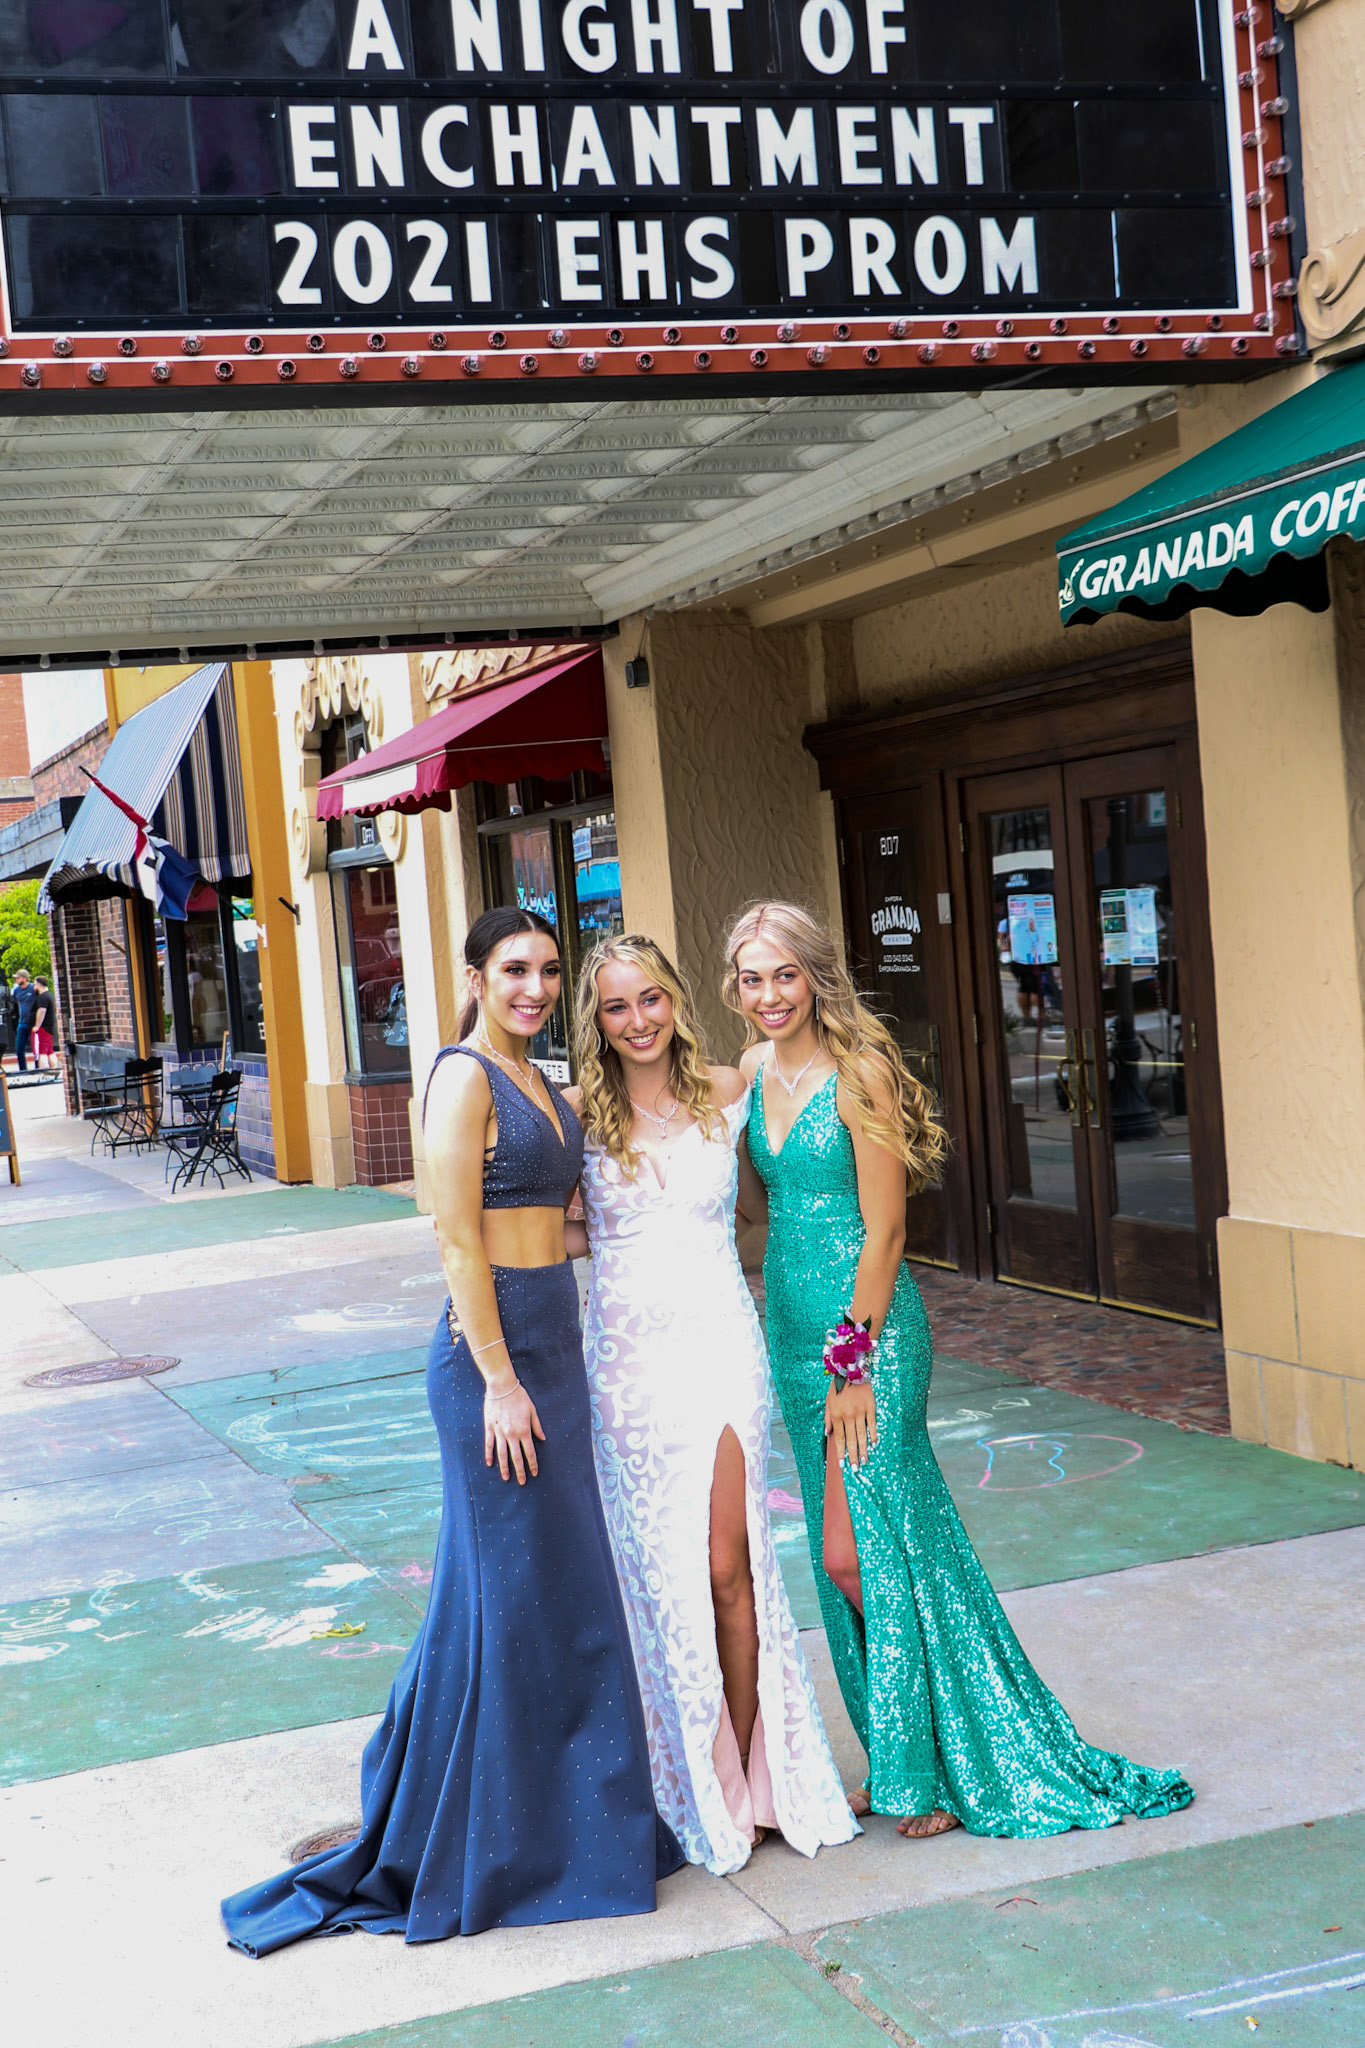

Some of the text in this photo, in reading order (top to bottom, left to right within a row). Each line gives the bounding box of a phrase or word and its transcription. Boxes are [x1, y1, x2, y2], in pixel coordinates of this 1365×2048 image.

[348, 0, 906, 74] A NIGHT OF
[289, 105, 994, 187] ENCHANTMENT
[274, 216, 1038, 304] 2021 EHS PROM
[1079, 514, 1254, 599] GRANADA
[880, 836, 899, 856] 807
[871, 904, 921, 935] GRANADA
